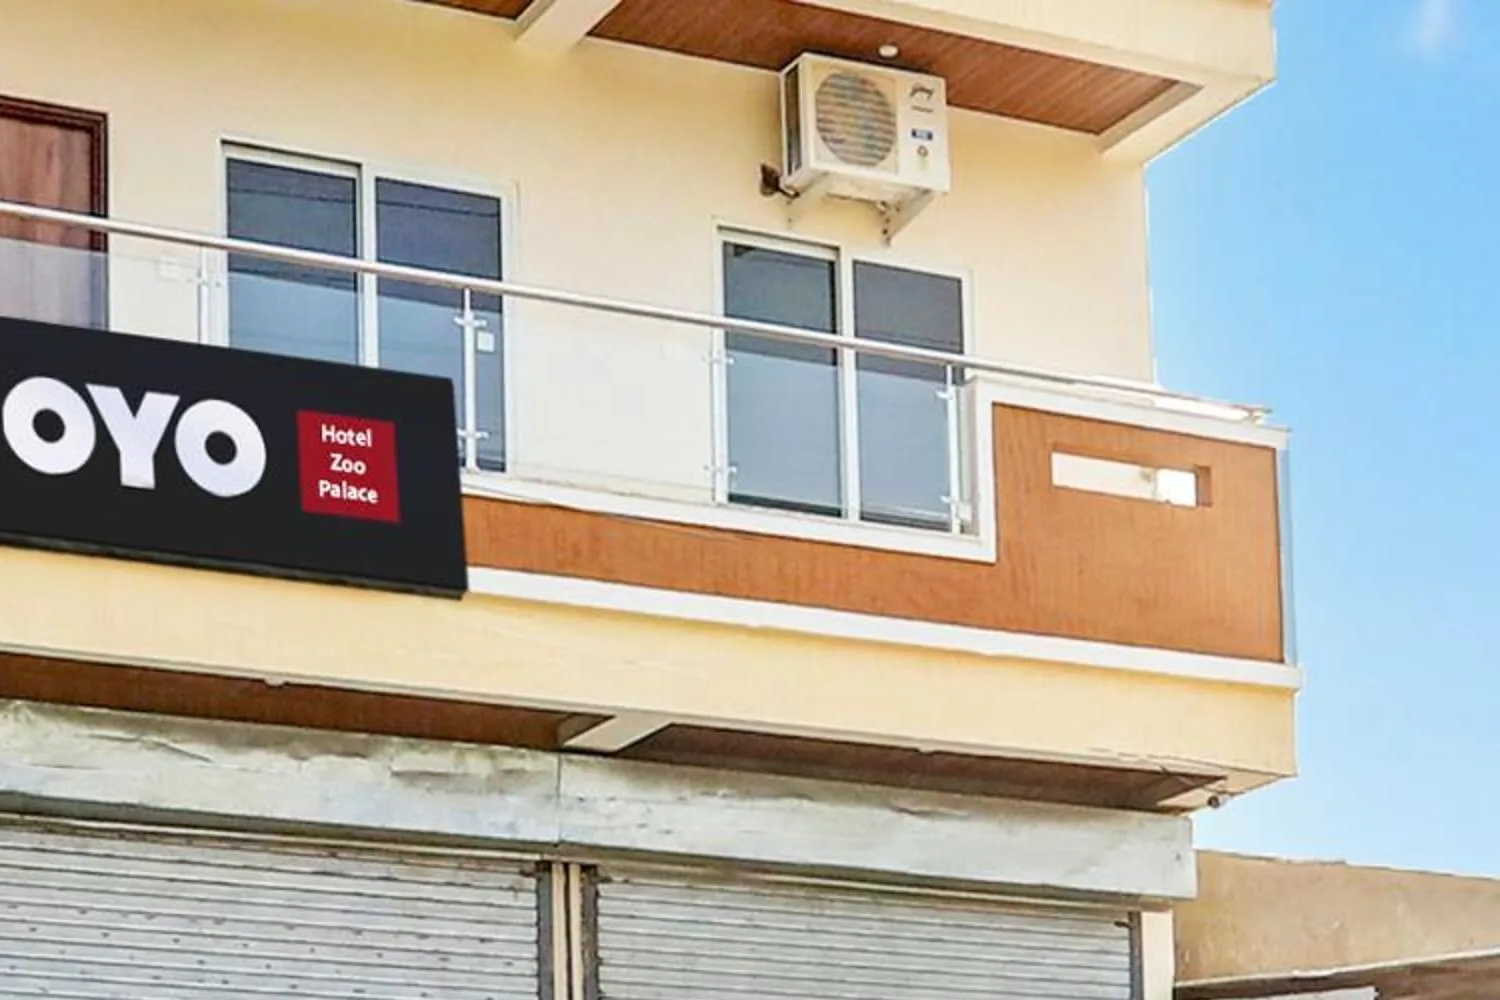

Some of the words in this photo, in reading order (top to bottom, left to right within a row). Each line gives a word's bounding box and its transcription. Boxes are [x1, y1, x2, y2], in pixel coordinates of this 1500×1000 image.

[2, 376, 267, 498] OYO
[321, 423, 372, 448] Hotel
[329, 452, 367, 475] Zoo
[318, 479, 379, 504] Palace
